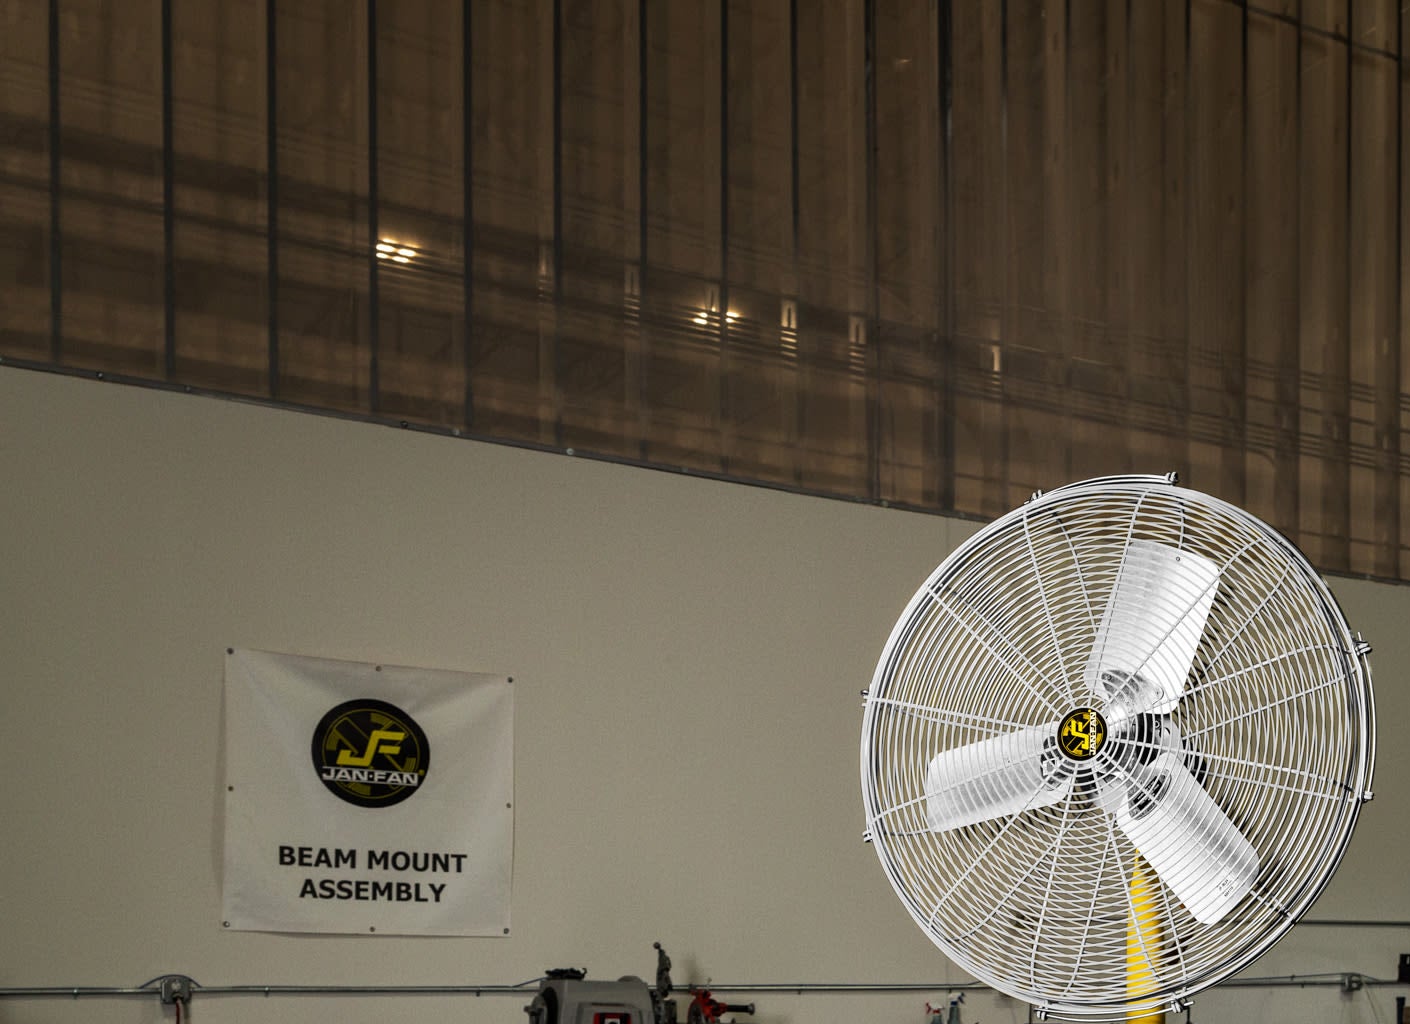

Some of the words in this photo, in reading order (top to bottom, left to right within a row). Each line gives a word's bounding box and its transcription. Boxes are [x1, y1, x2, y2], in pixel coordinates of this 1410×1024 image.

[278, 846, 357, 869] BEAM
[367, 850, 468, 873] MOUNT
[299, 879, 447, 902] ASSEMBLY
